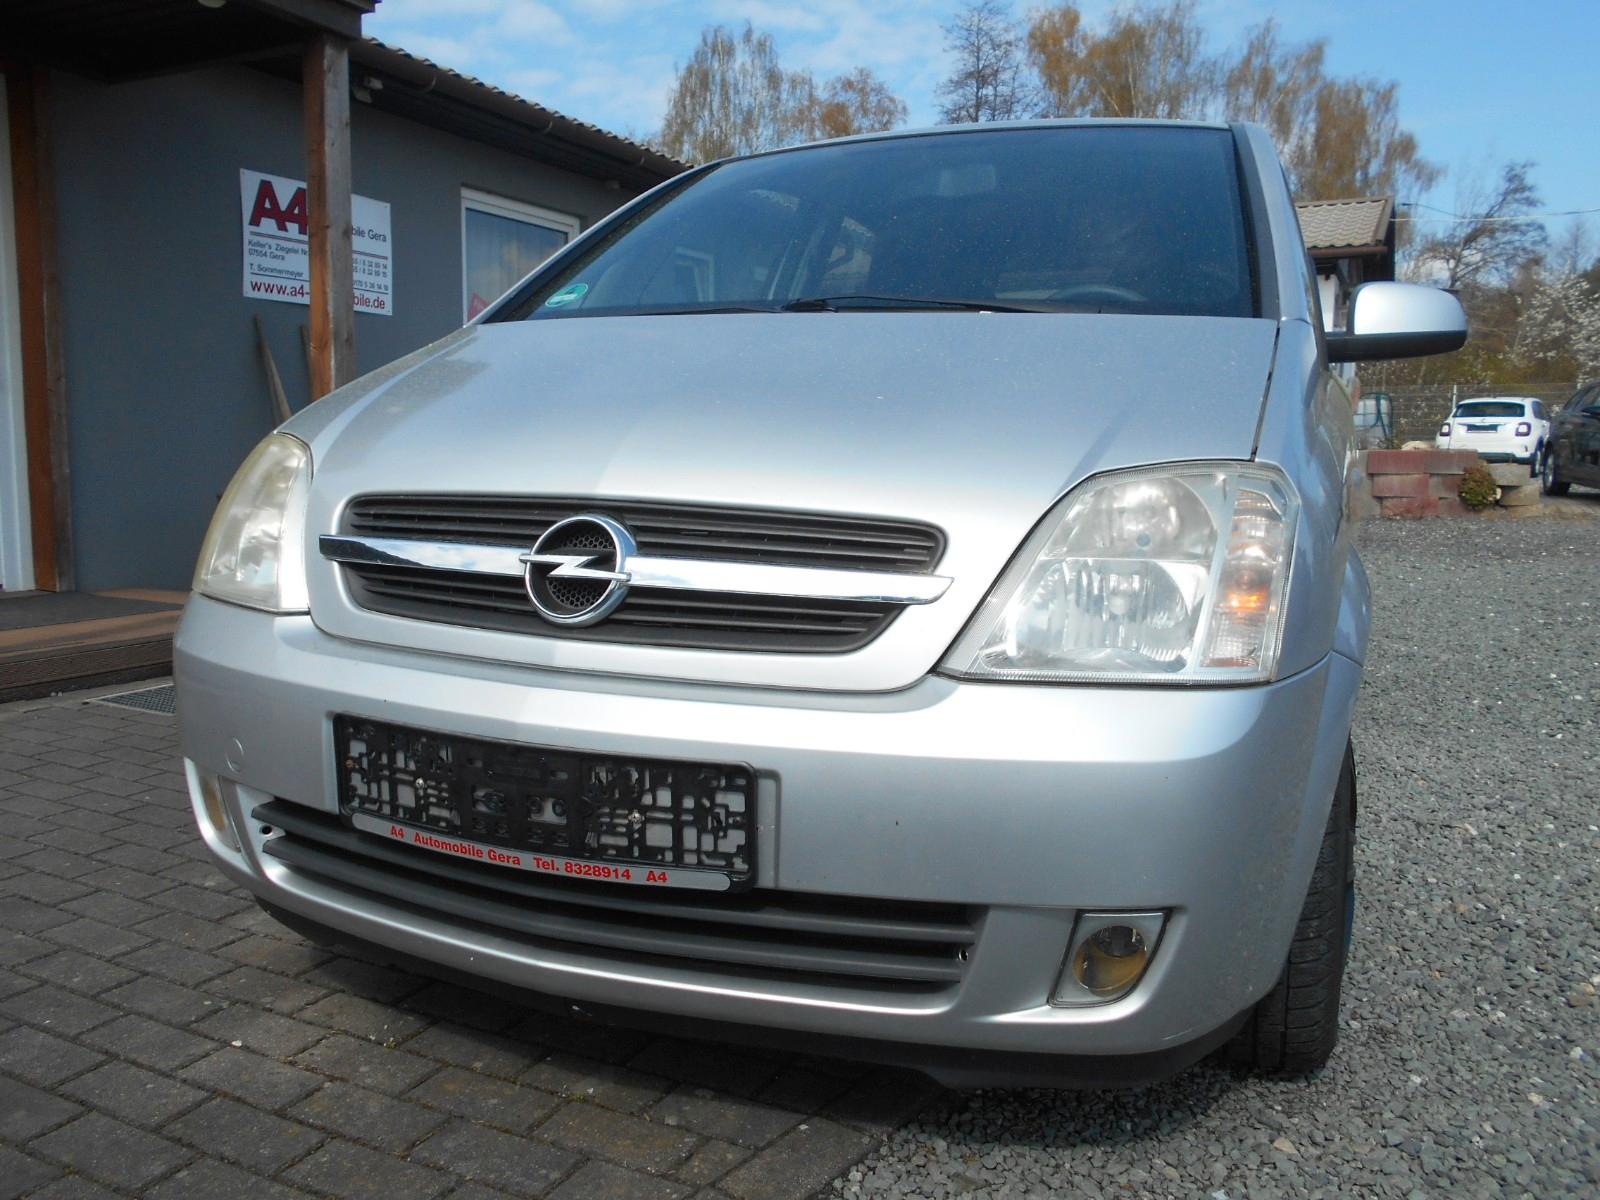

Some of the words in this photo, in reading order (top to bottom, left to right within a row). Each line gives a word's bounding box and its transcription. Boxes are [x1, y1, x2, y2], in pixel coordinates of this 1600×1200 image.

[352, 223, 366, 238] bile
[367, 226, 387, 242] Gera
[269, 251, 286, 261] Gera
[352, 293, 386, 309] bile.de
[390, 825, 405, 839] A4
[414, 832, 484, 858] Automobile
[488, 848, 521, 866] Gera
[533, 857, 559, 871] Tel.
[564, 861, 632, 880] 8328914
[646, 870, 668, 883] A4
